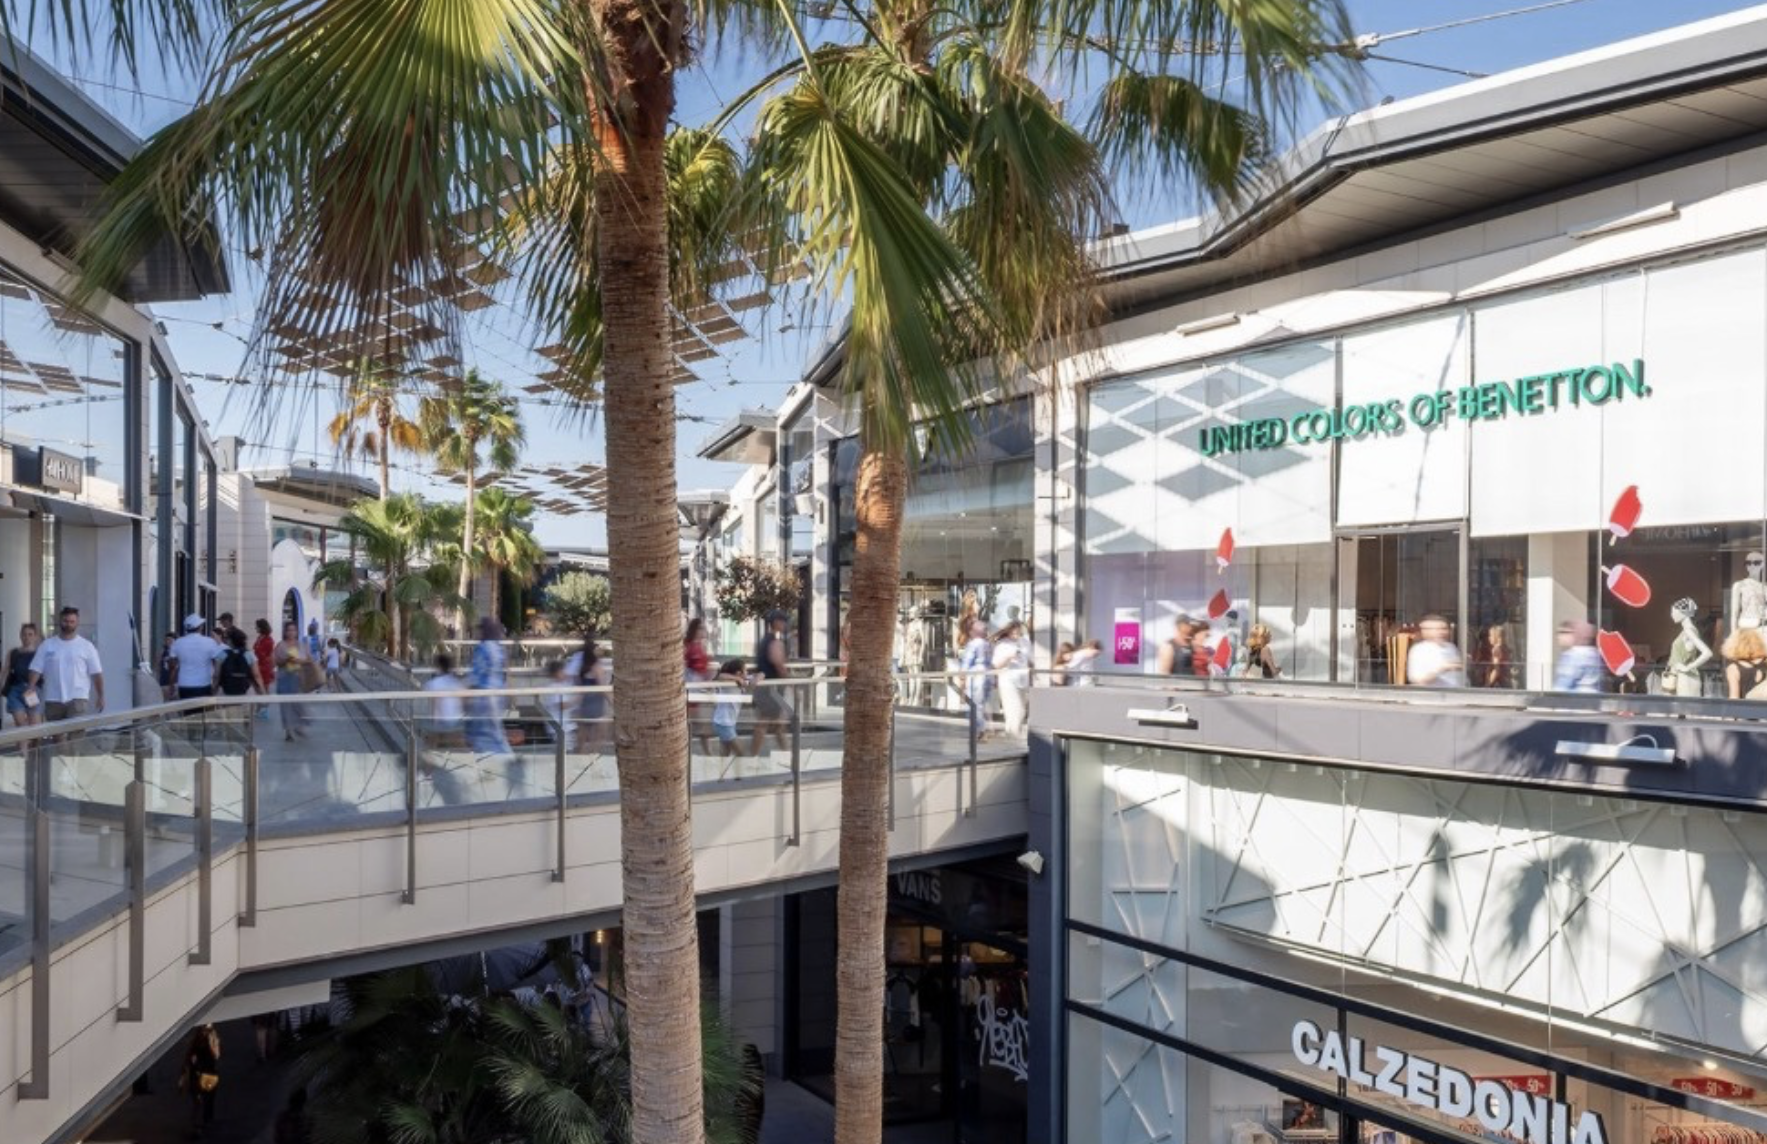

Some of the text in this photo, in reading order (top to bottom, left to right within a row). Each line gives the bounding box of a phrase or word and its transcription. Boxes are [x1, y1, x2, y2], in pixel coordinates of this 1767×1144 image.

[1199, 416, 1287, 457] UNITED
[1289, 399, 1401, 444] COLORS
[1408, 391, 1453, 426] OF
[897, 872, 942, 905] VANS
[1291, 1020, 1607, 1144] CALZEDONIA
